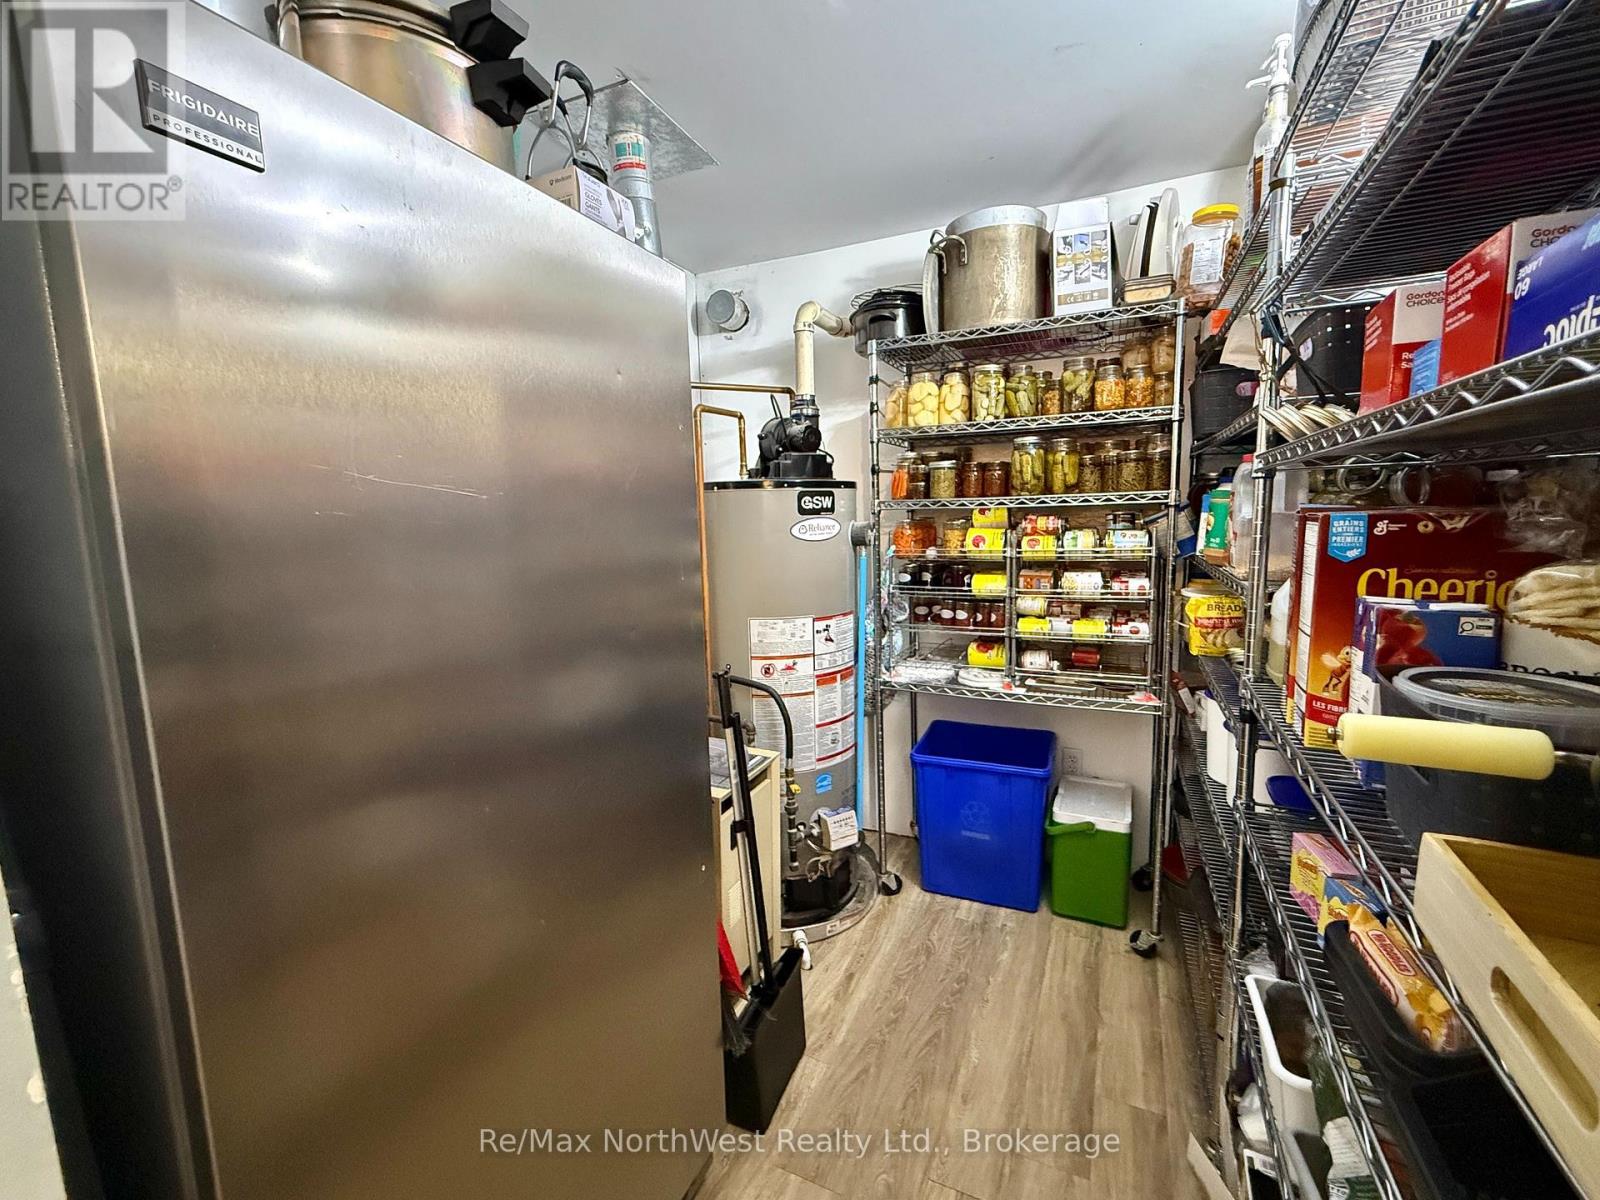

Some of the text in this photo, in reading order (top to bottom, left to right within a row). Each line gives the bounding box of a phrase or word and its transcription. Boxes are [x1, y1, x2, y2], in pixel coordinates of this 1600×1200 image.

[149, 81, 260, 137] FRIGIDAIRE
[152, 113, 263, 164] PROFESSIONAL
[1514, 277, 1531, 301] 60
[801, 495, 833, 510] GSW
[1356, 567, 1514, 612] Cheerio
[1207, 604, 1242, 612] BREAD
[1312, 700, 1326, 709] LES
